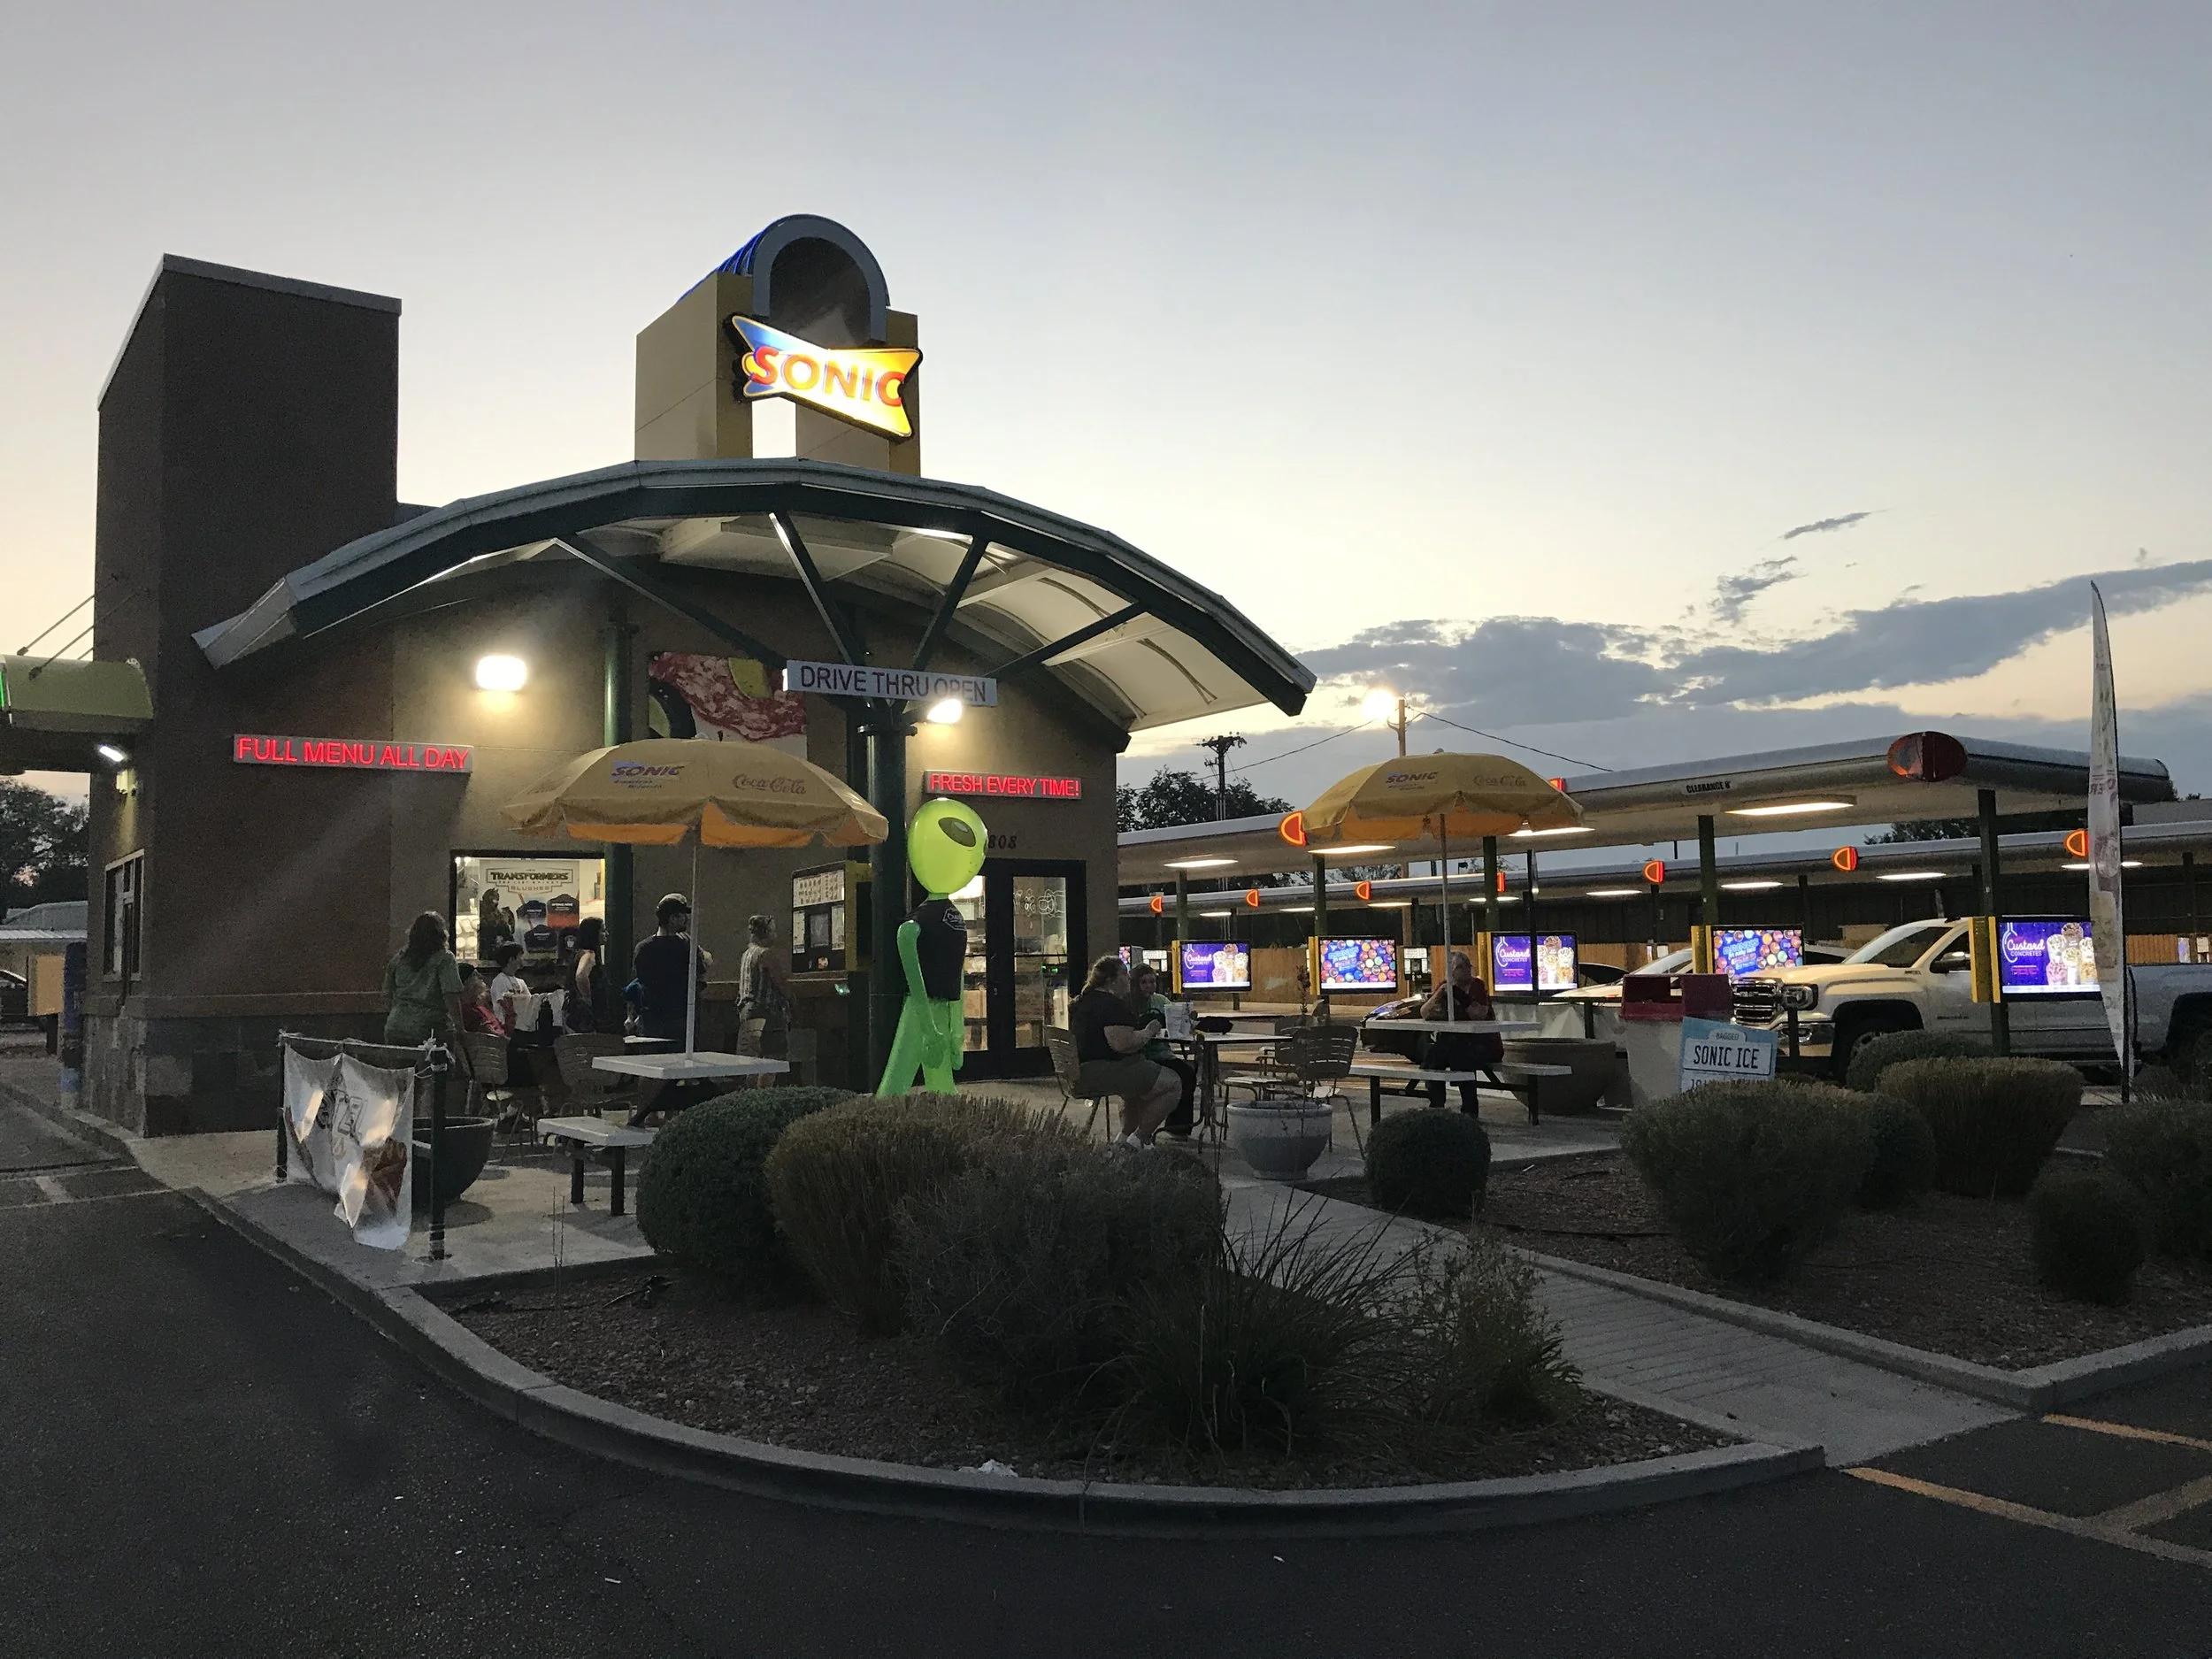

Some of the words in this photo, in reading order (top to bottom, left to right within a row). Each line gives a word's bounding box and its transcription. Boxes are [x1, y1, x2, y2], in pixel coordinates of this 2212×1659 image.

[750, 346, 906, 407] SONIC
[800, 665, 866, 692] DRIVE
[872, 672, 929, 697] THRU
[933, 677, 987, 703] OPEN
[237, 737, 297, 762] FULL
[303, 741, 375, 765] MENU
[380, 745, 419, 767] ALL
[425, 747, 469, 769] DAY
[611, 765, 685, 777] SONIC
[1386, 771, 1439, 784] SONIC
[732, 772, 807, 795] Coca-Cola
[930, 773, 983, 794] FRESH
[987, 776, 1038, 795] EVERY
[1040, 778, 1080, 797] TIME!
[1686, 782, 1724, 794] CLEARANCE
[490, 872, 569, 880] TRANSFORMERS
[2007, 939, 2046, 950] Custard
[1500, 949, 1531, 958] Custard
[1716, 1032, 1740, 1041] BAGGED
[1694, 1045, 1732, 1067] SONIC
[1736, 1048, 1760, 1069] ICE
